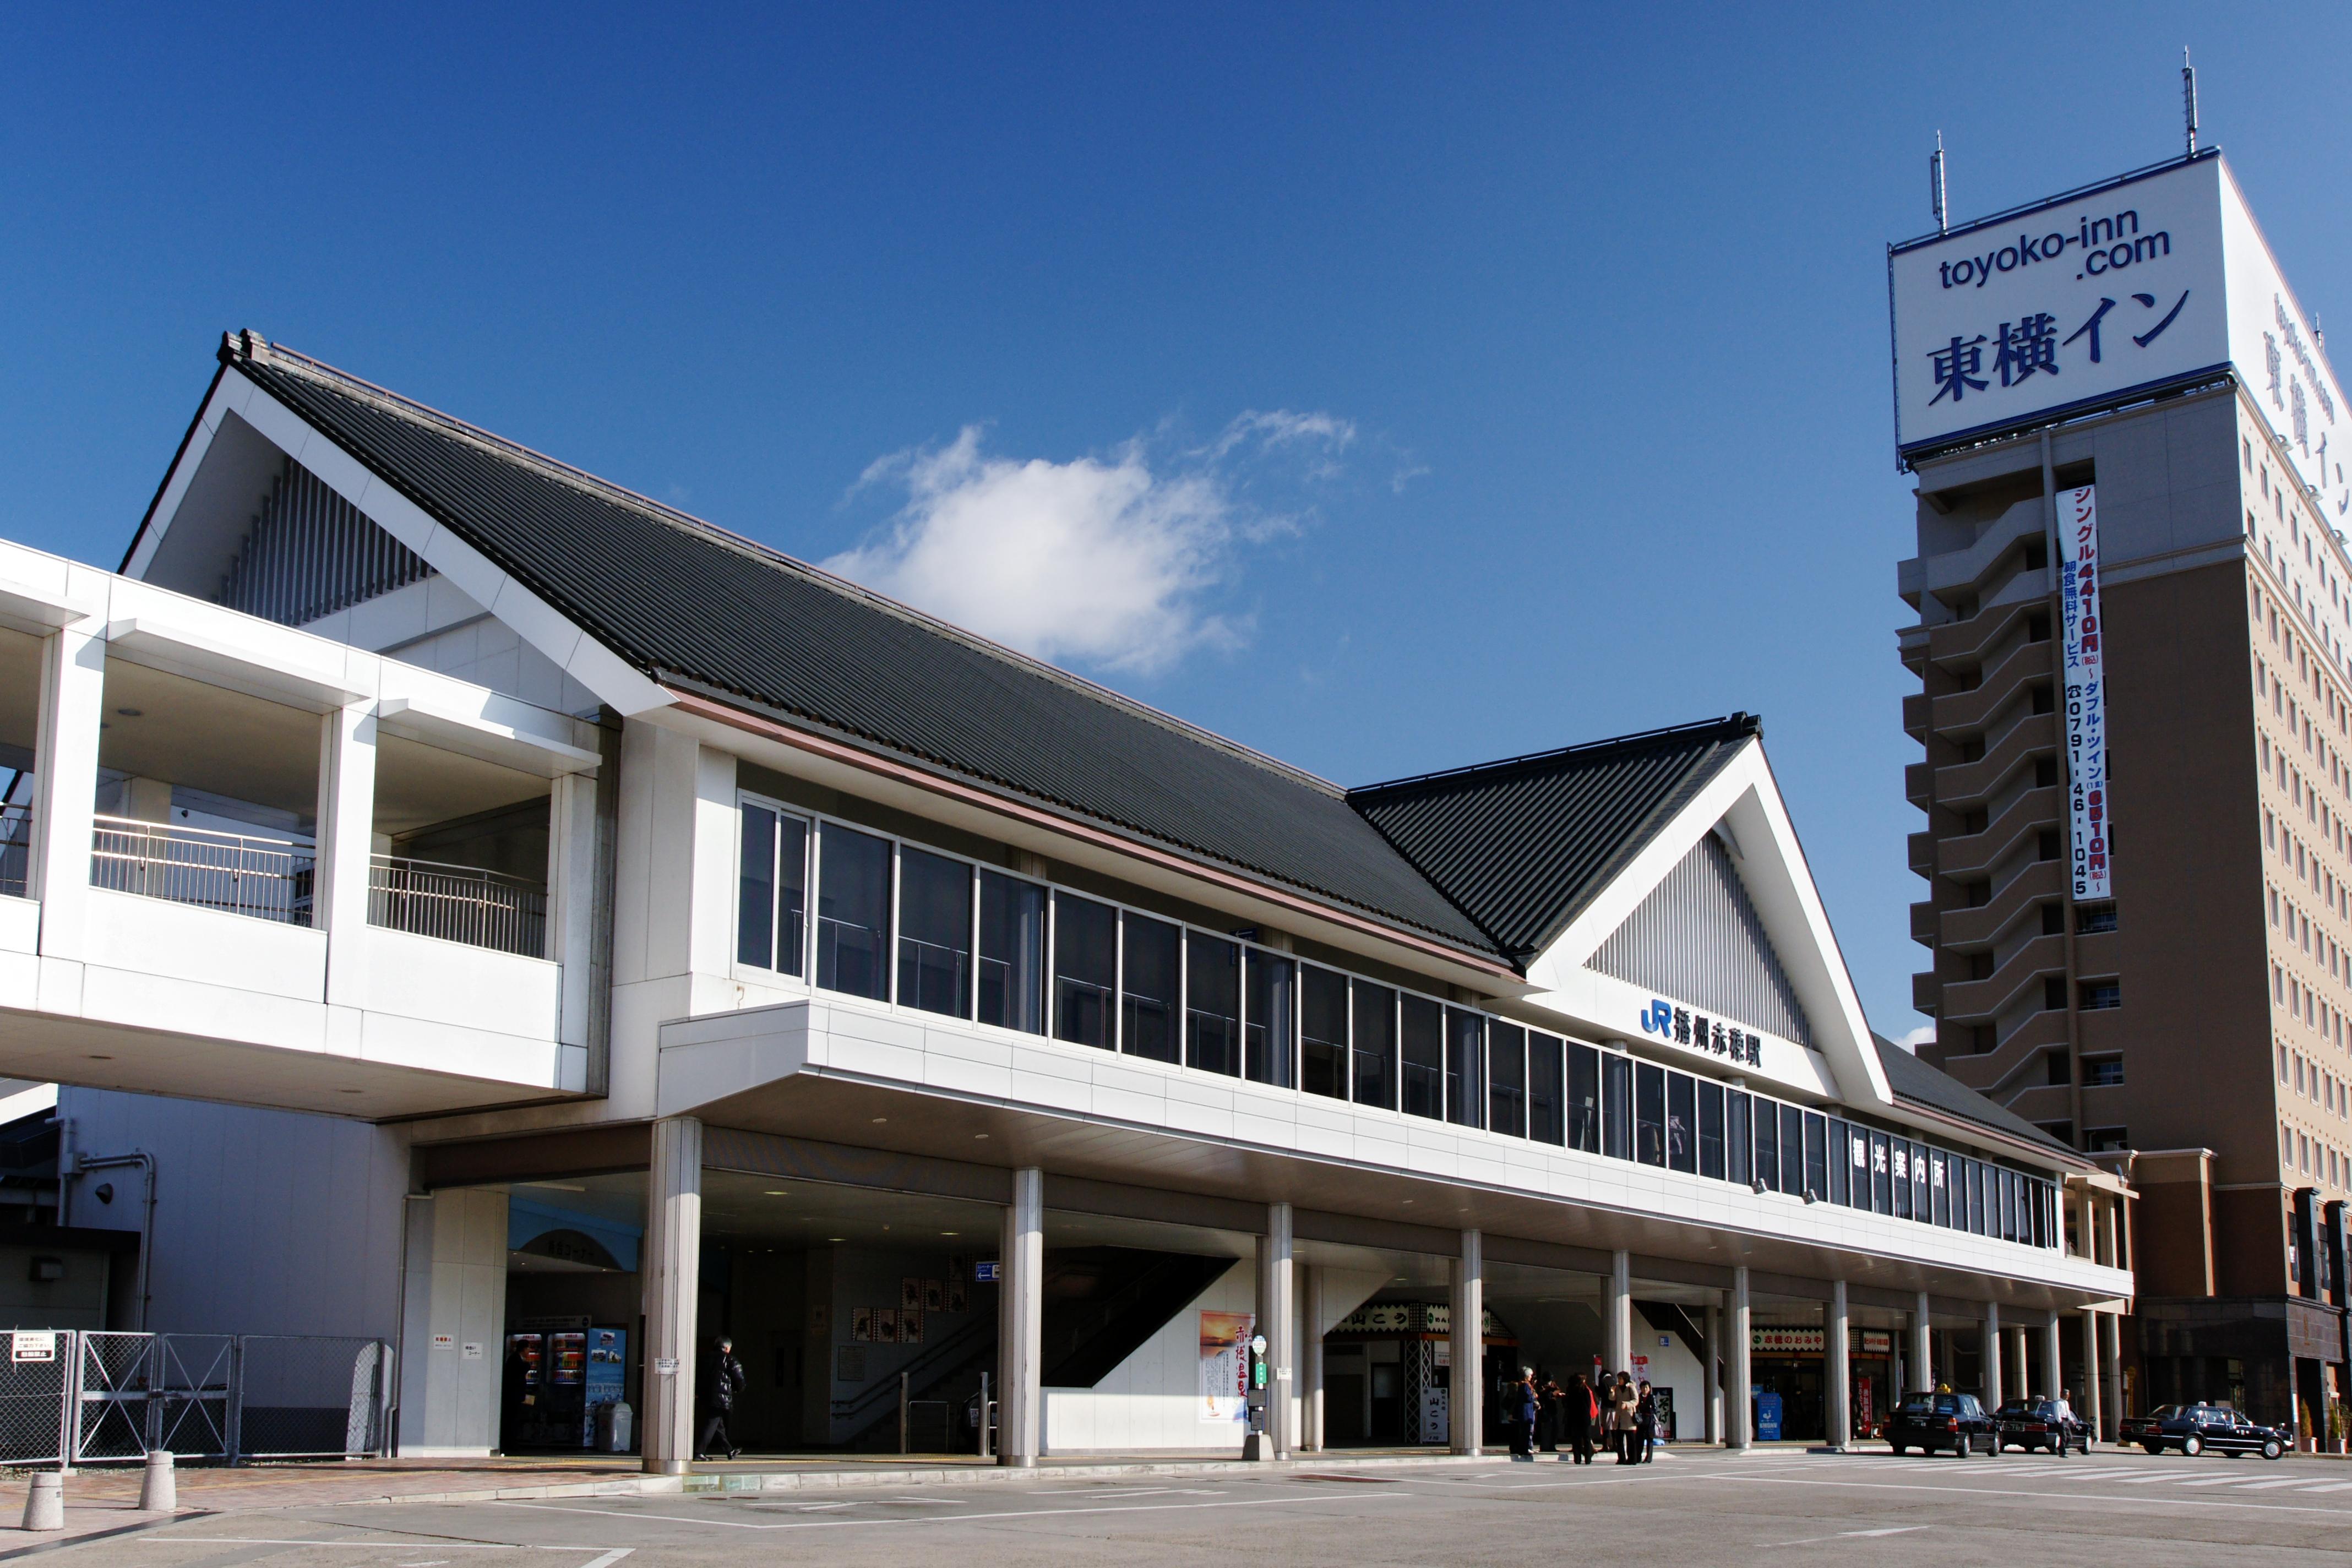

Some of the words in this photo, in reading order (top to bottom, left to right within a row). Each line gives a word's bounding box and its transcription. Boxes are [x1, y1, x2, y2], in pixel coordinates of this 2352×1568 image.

[1939, 209, 2138, 288] toyoko-inn
[2076, 231, 2170, 280] .com
[1928, 290, 2189, 407] 東横イン
[2064, 561, 2079, 668] 朝食無料サービス
[1641, 999, 1672, 1037] JR
[1674, 1007, 1762, 1068] 播州赤穂駅
[1853, 1137, 1944, 1188] 観光案内所
